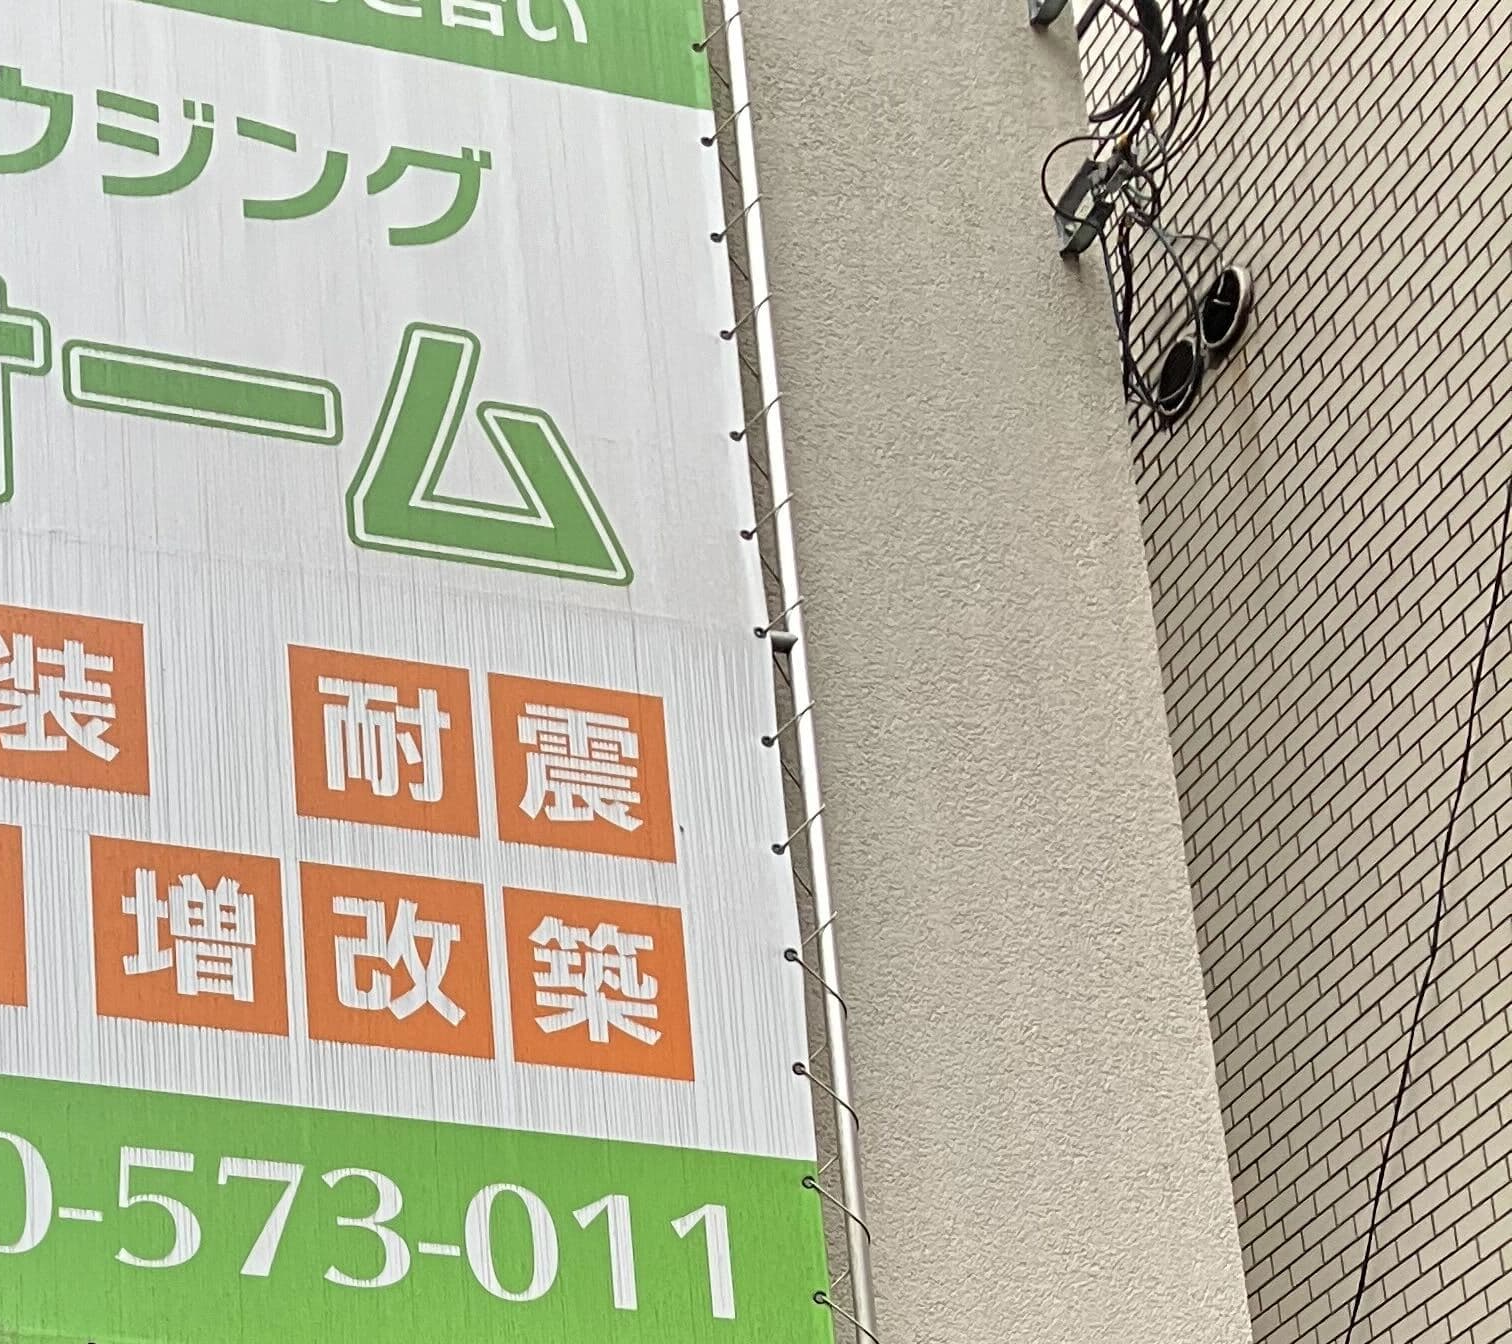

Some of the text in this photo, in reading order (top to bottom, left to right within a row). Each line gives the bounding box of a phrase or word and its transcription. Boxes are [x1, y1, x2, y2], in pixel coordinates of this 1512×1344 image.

[318, 676, 646, 833] 耐震
[119, 870, 662, 1050] 増改築
